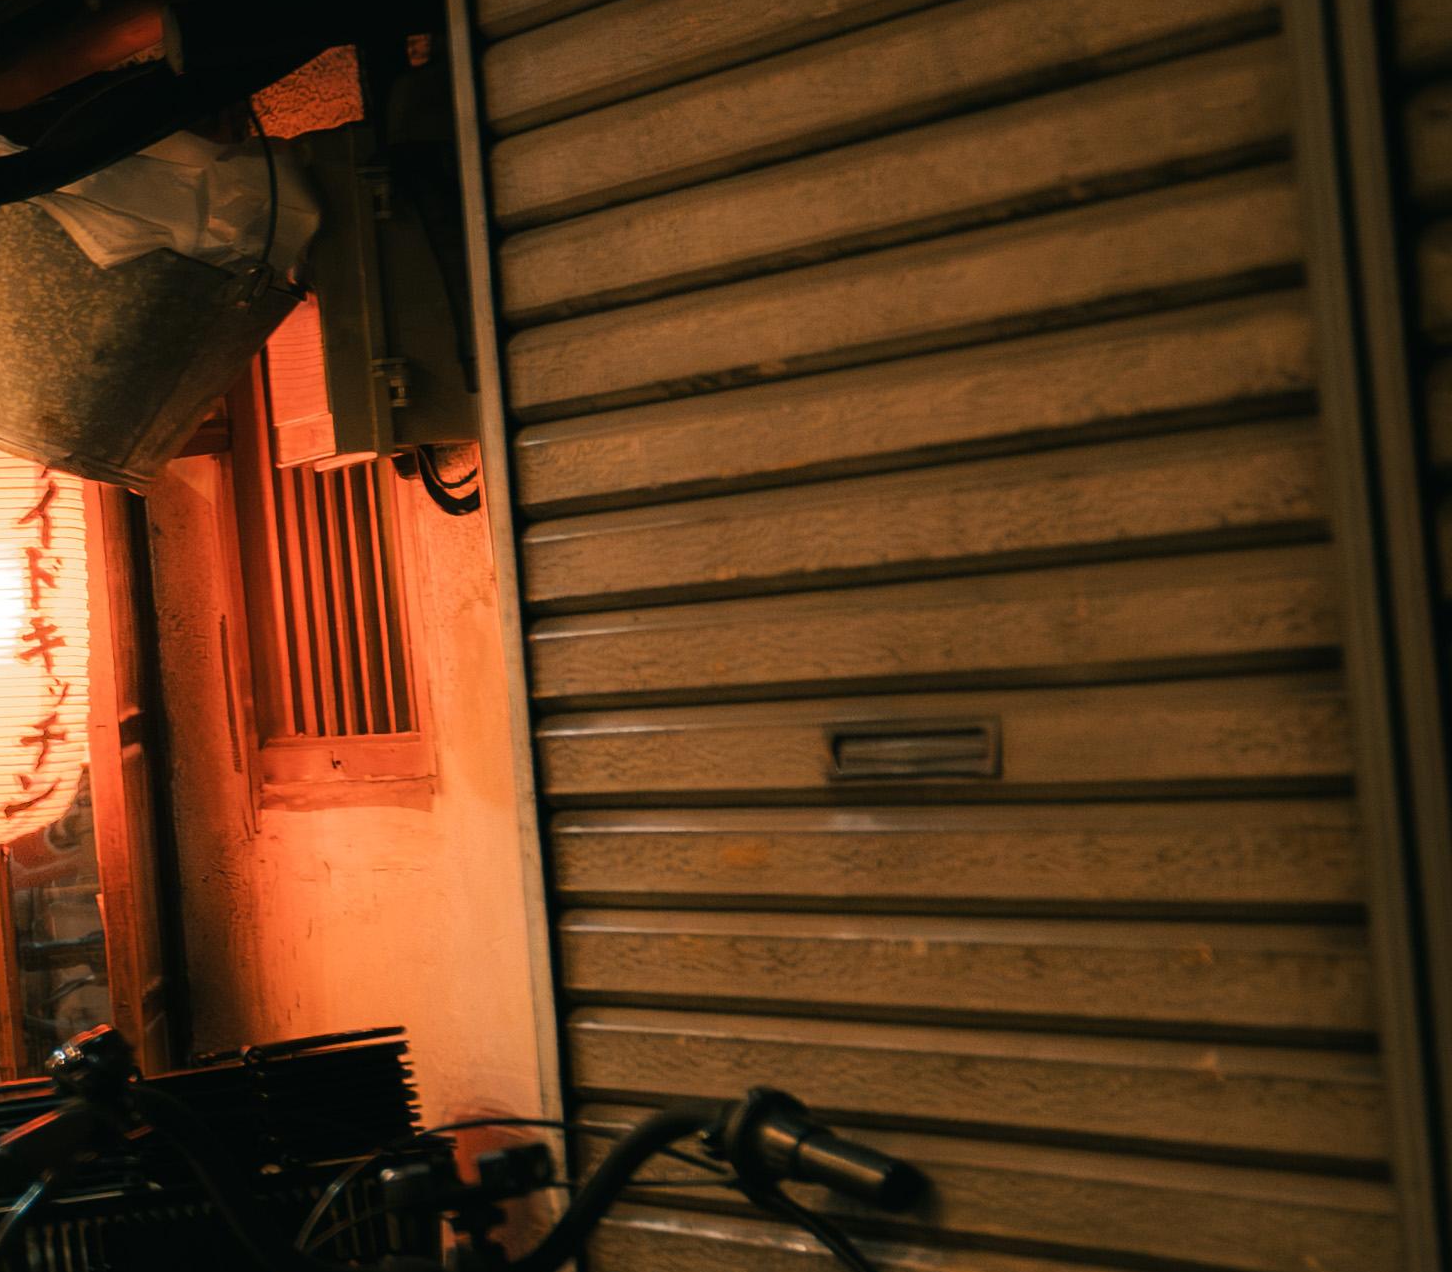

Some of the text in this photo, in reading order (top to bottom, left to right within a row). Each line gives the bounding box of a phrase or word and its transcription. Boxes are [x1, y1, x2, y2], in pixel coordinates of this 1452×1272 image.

[4, 465, 72, 821] イドキッチン
